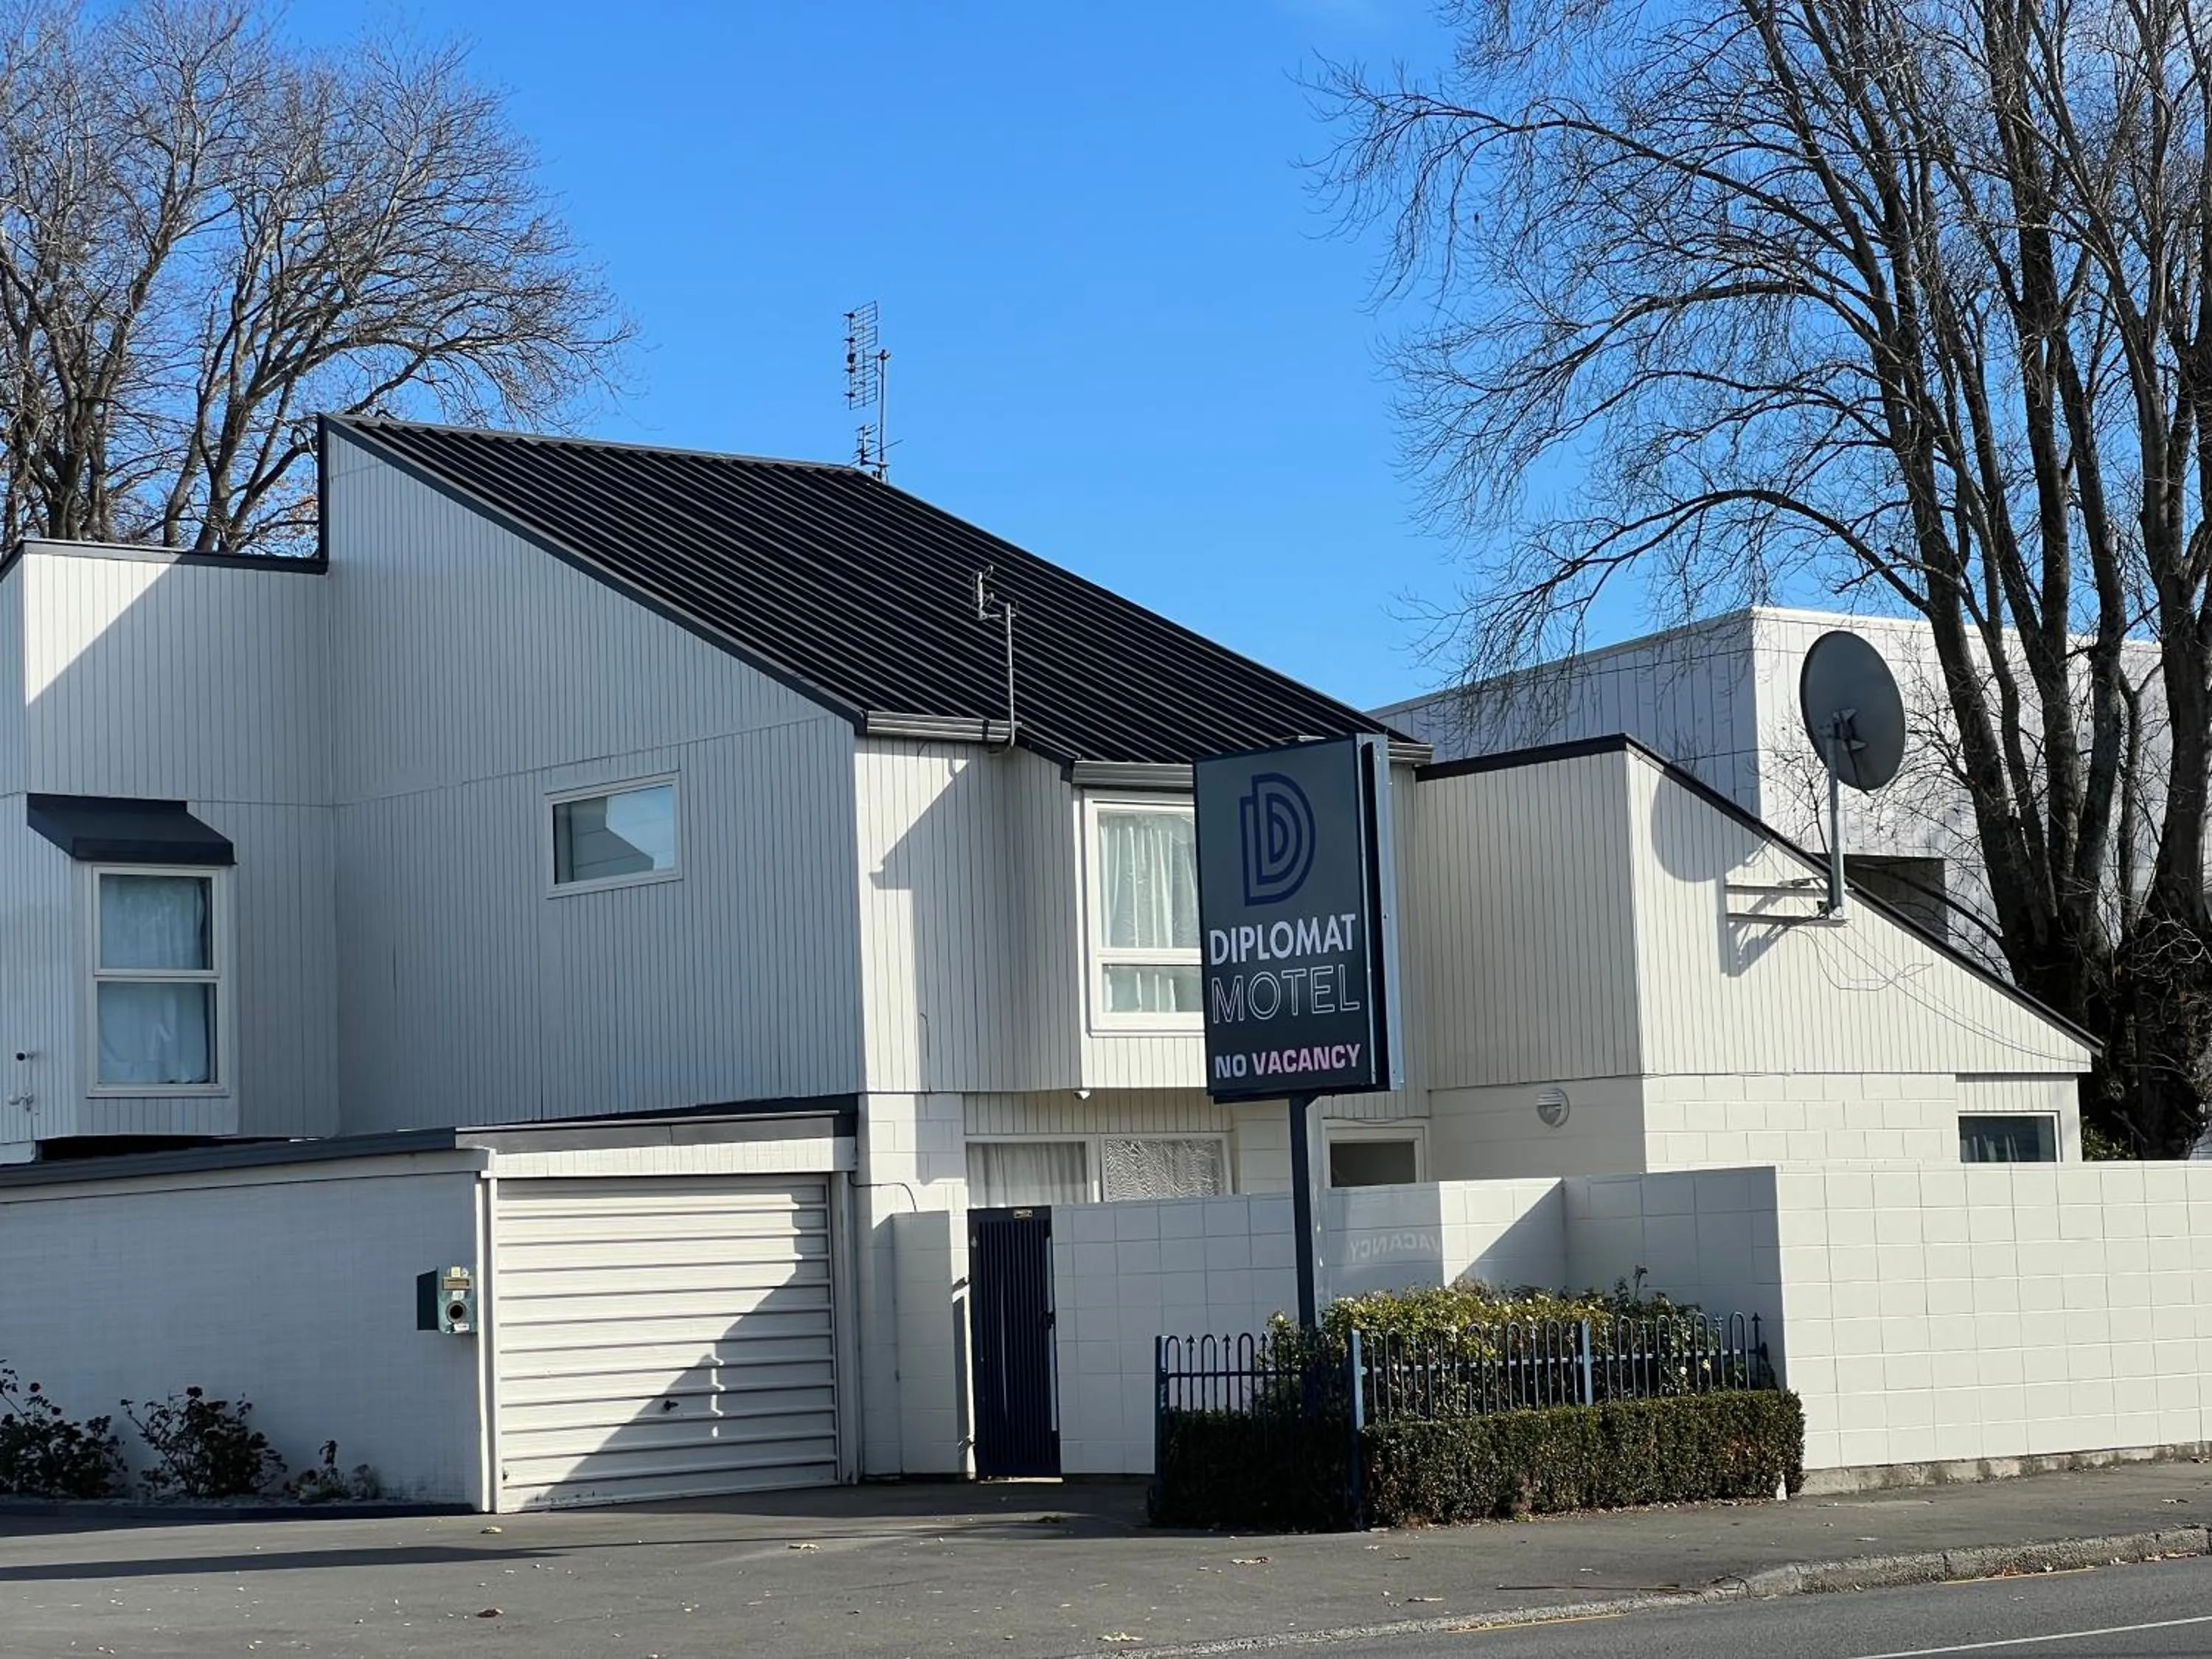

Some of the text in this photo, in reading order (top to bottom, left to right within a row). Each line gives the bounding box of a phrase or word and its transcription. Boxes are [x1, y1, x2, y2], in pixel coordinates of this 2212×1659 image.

[1209, 914, 1356, 966] DIPLOMAT
[1211, 964, 1360, 1024] MOTEL
[1215, 1043, 1361, 1079] NO VACANCY
